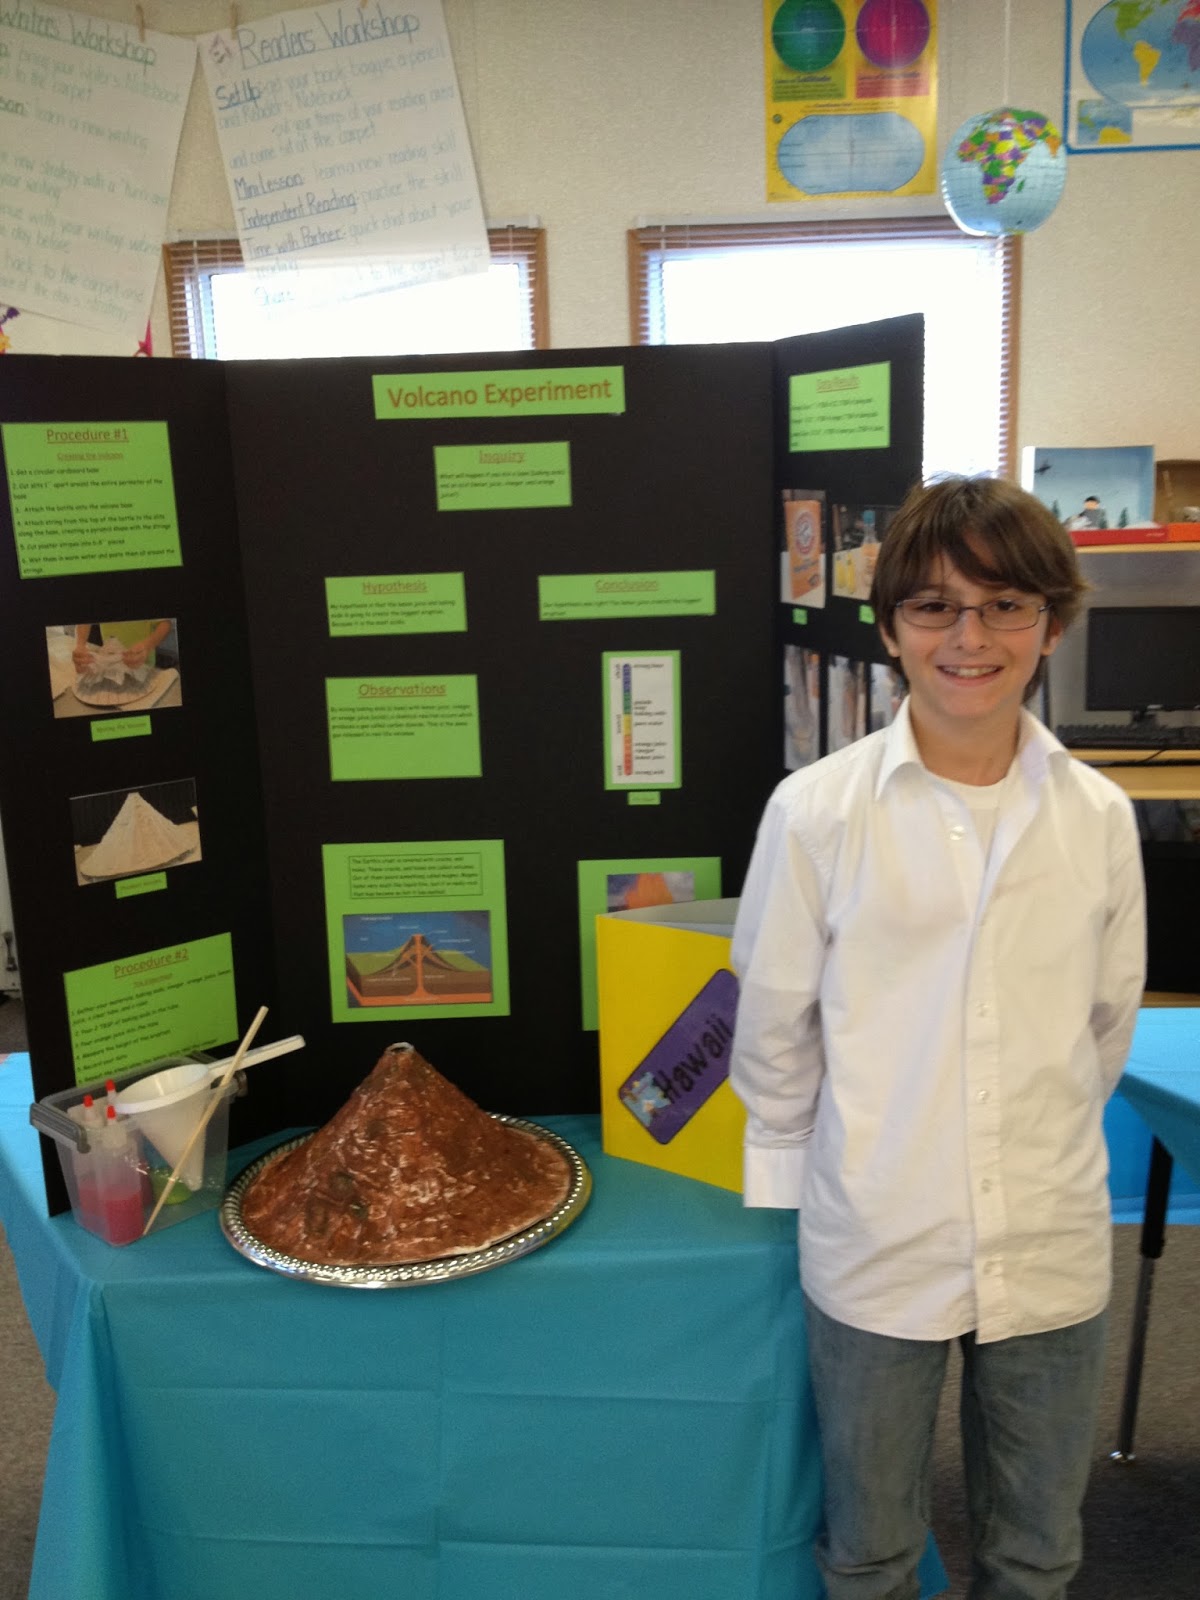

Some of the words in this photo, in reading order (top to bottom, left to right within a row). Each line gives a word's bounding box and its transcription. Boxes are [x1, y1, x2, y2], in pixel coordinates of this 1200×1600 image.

[67, 12, 157, 76] Workshop
[235, 15, 316, 70] Readers
[313, 1, 421, 48] Workshop
[238, 195, 305, 231] Independent
[387, 386, 478, 408] Volcano
[484, 379, 612, 407] Experiment
[47, 428, 111, 443] Procedure
[113, 428, 129, 441] #1
[479, 450, 525, 464] Inquiry
[362, 579, 427, 594] Hypothesis
[594, 579, 659, 593] Conclusion
[358, 682, 446, 698] Observations
[113, 954, 173, 978] Procedure
[175, 948, 189, 961] #2
[652, 1013, 733, 1104] Hawaii
